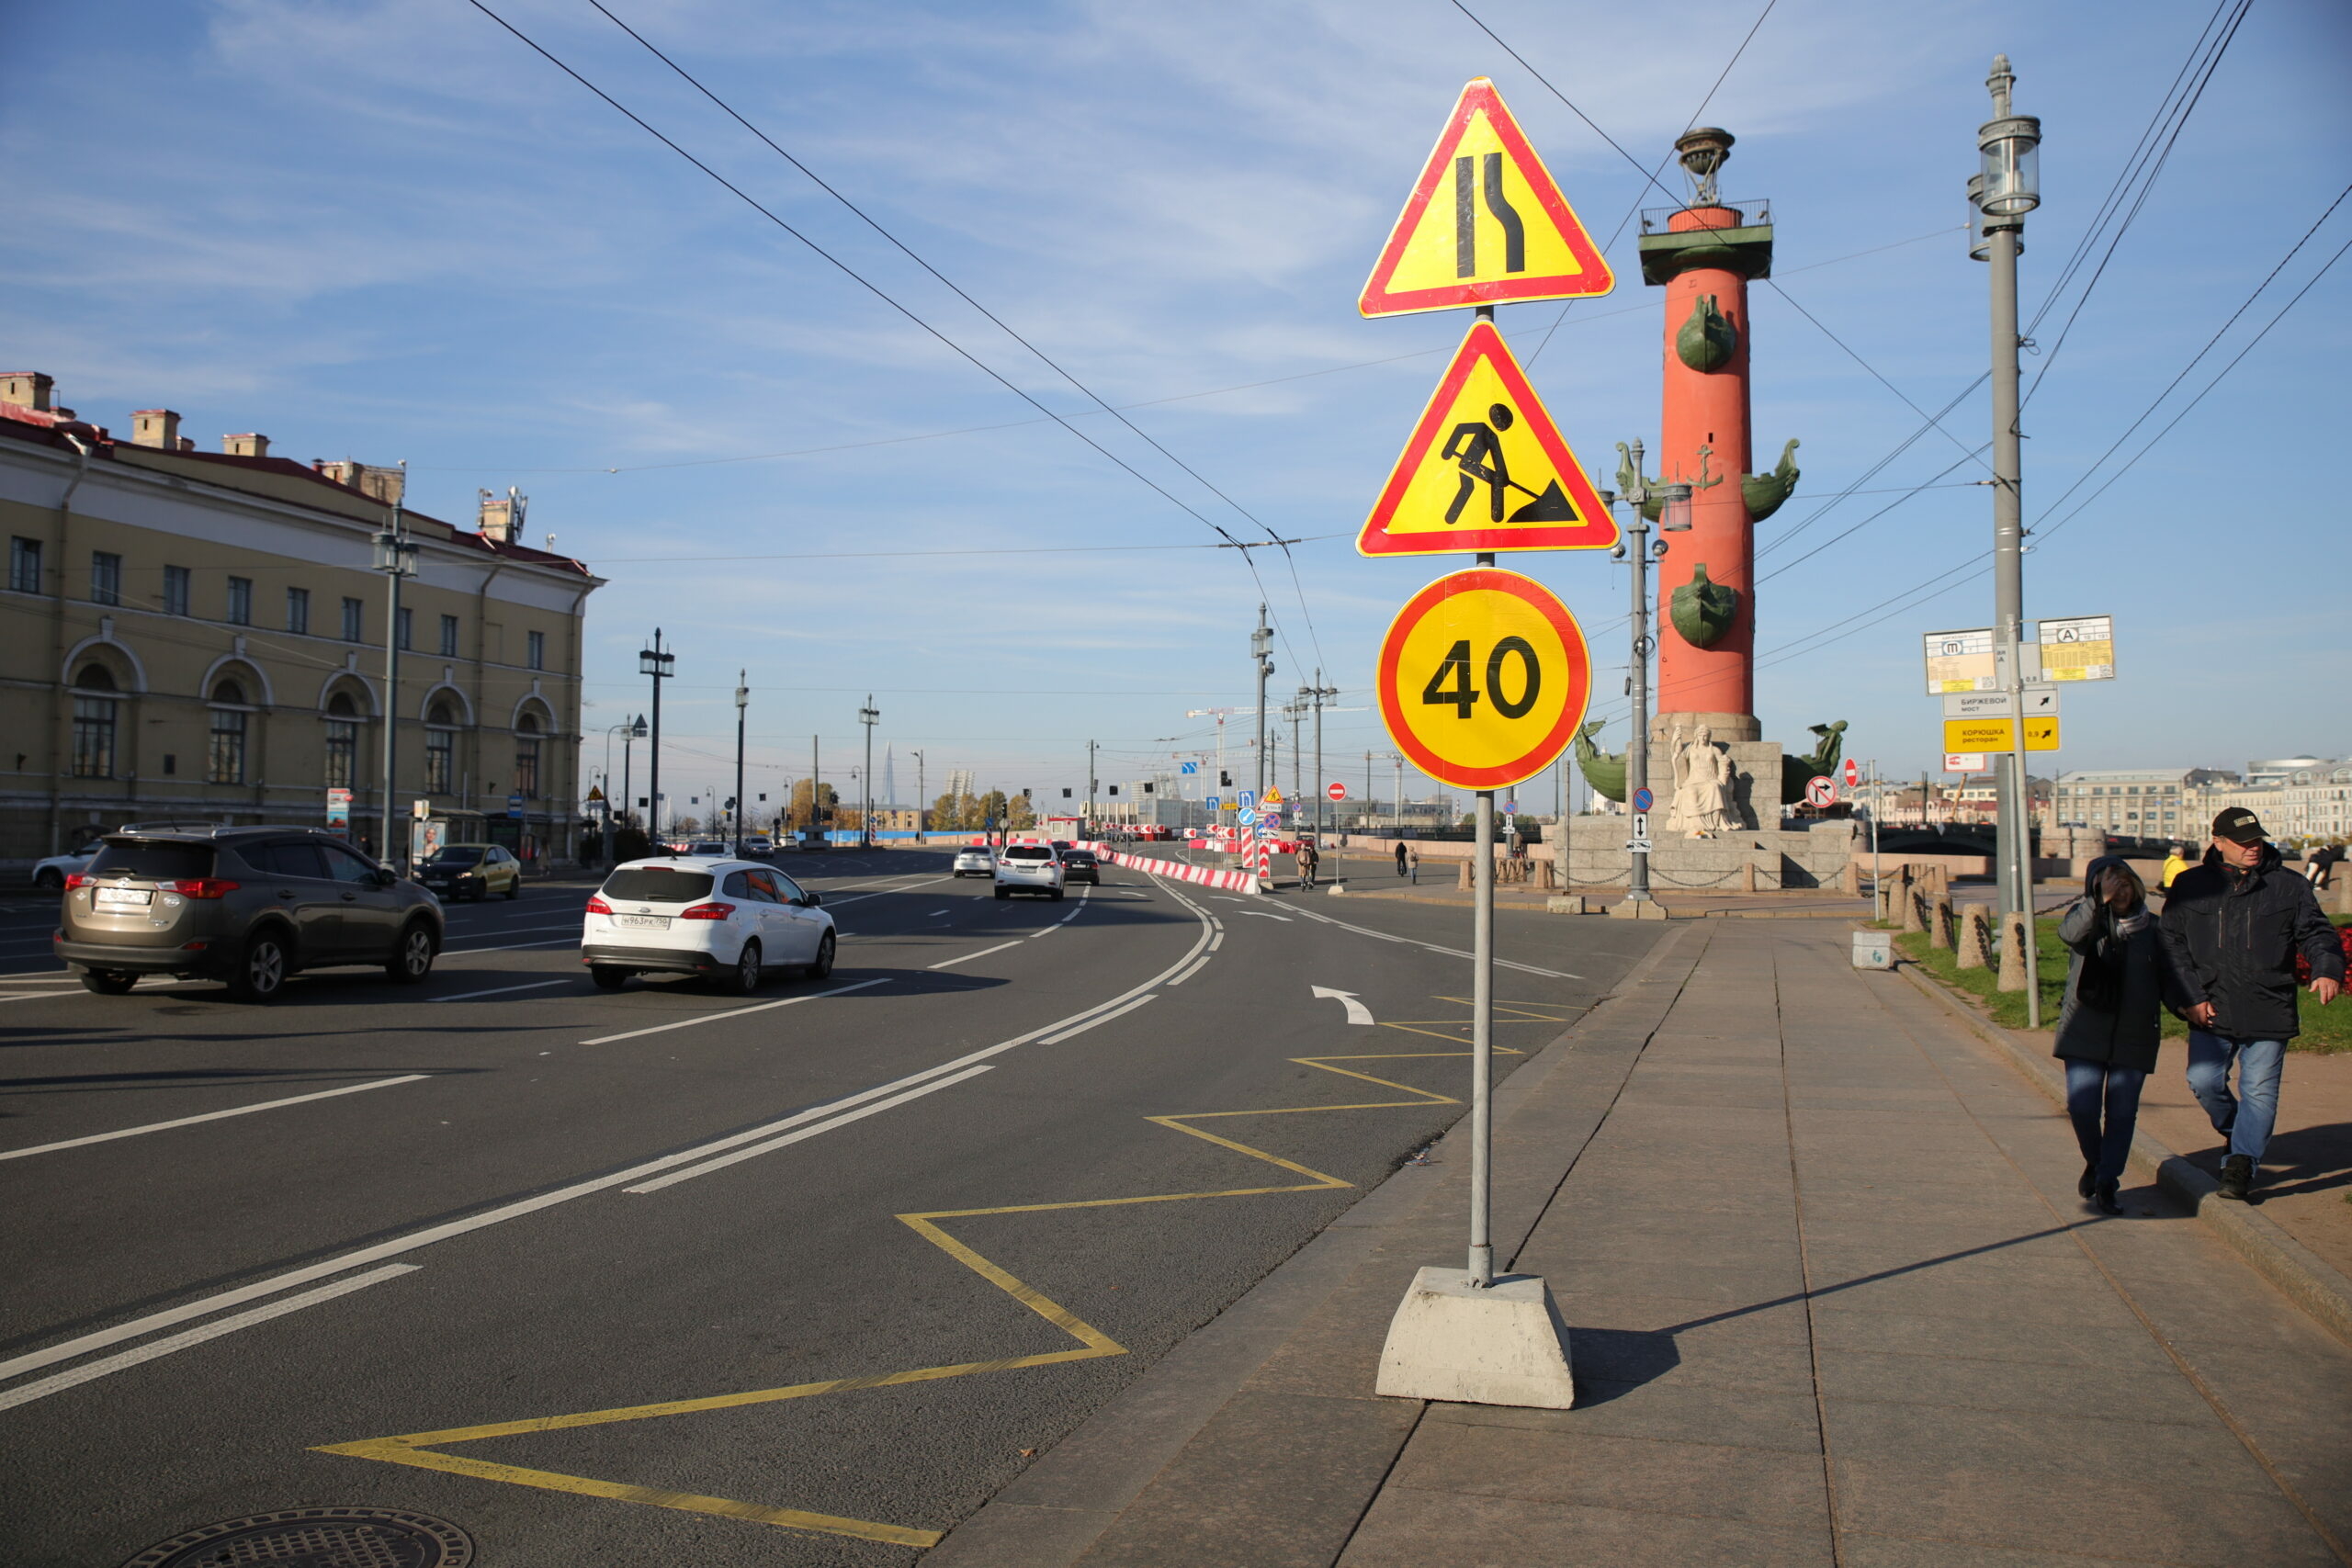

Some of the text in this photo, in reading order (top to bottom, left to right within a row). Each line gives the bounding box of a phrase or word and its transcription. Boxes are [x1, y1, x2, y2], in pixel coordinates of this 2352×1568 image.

[2063, 629, 2074, 640] А
[1422, 636, 1541, 719] 40
[1961, 697, 2007, 705] БИРЖЕВОЙ
